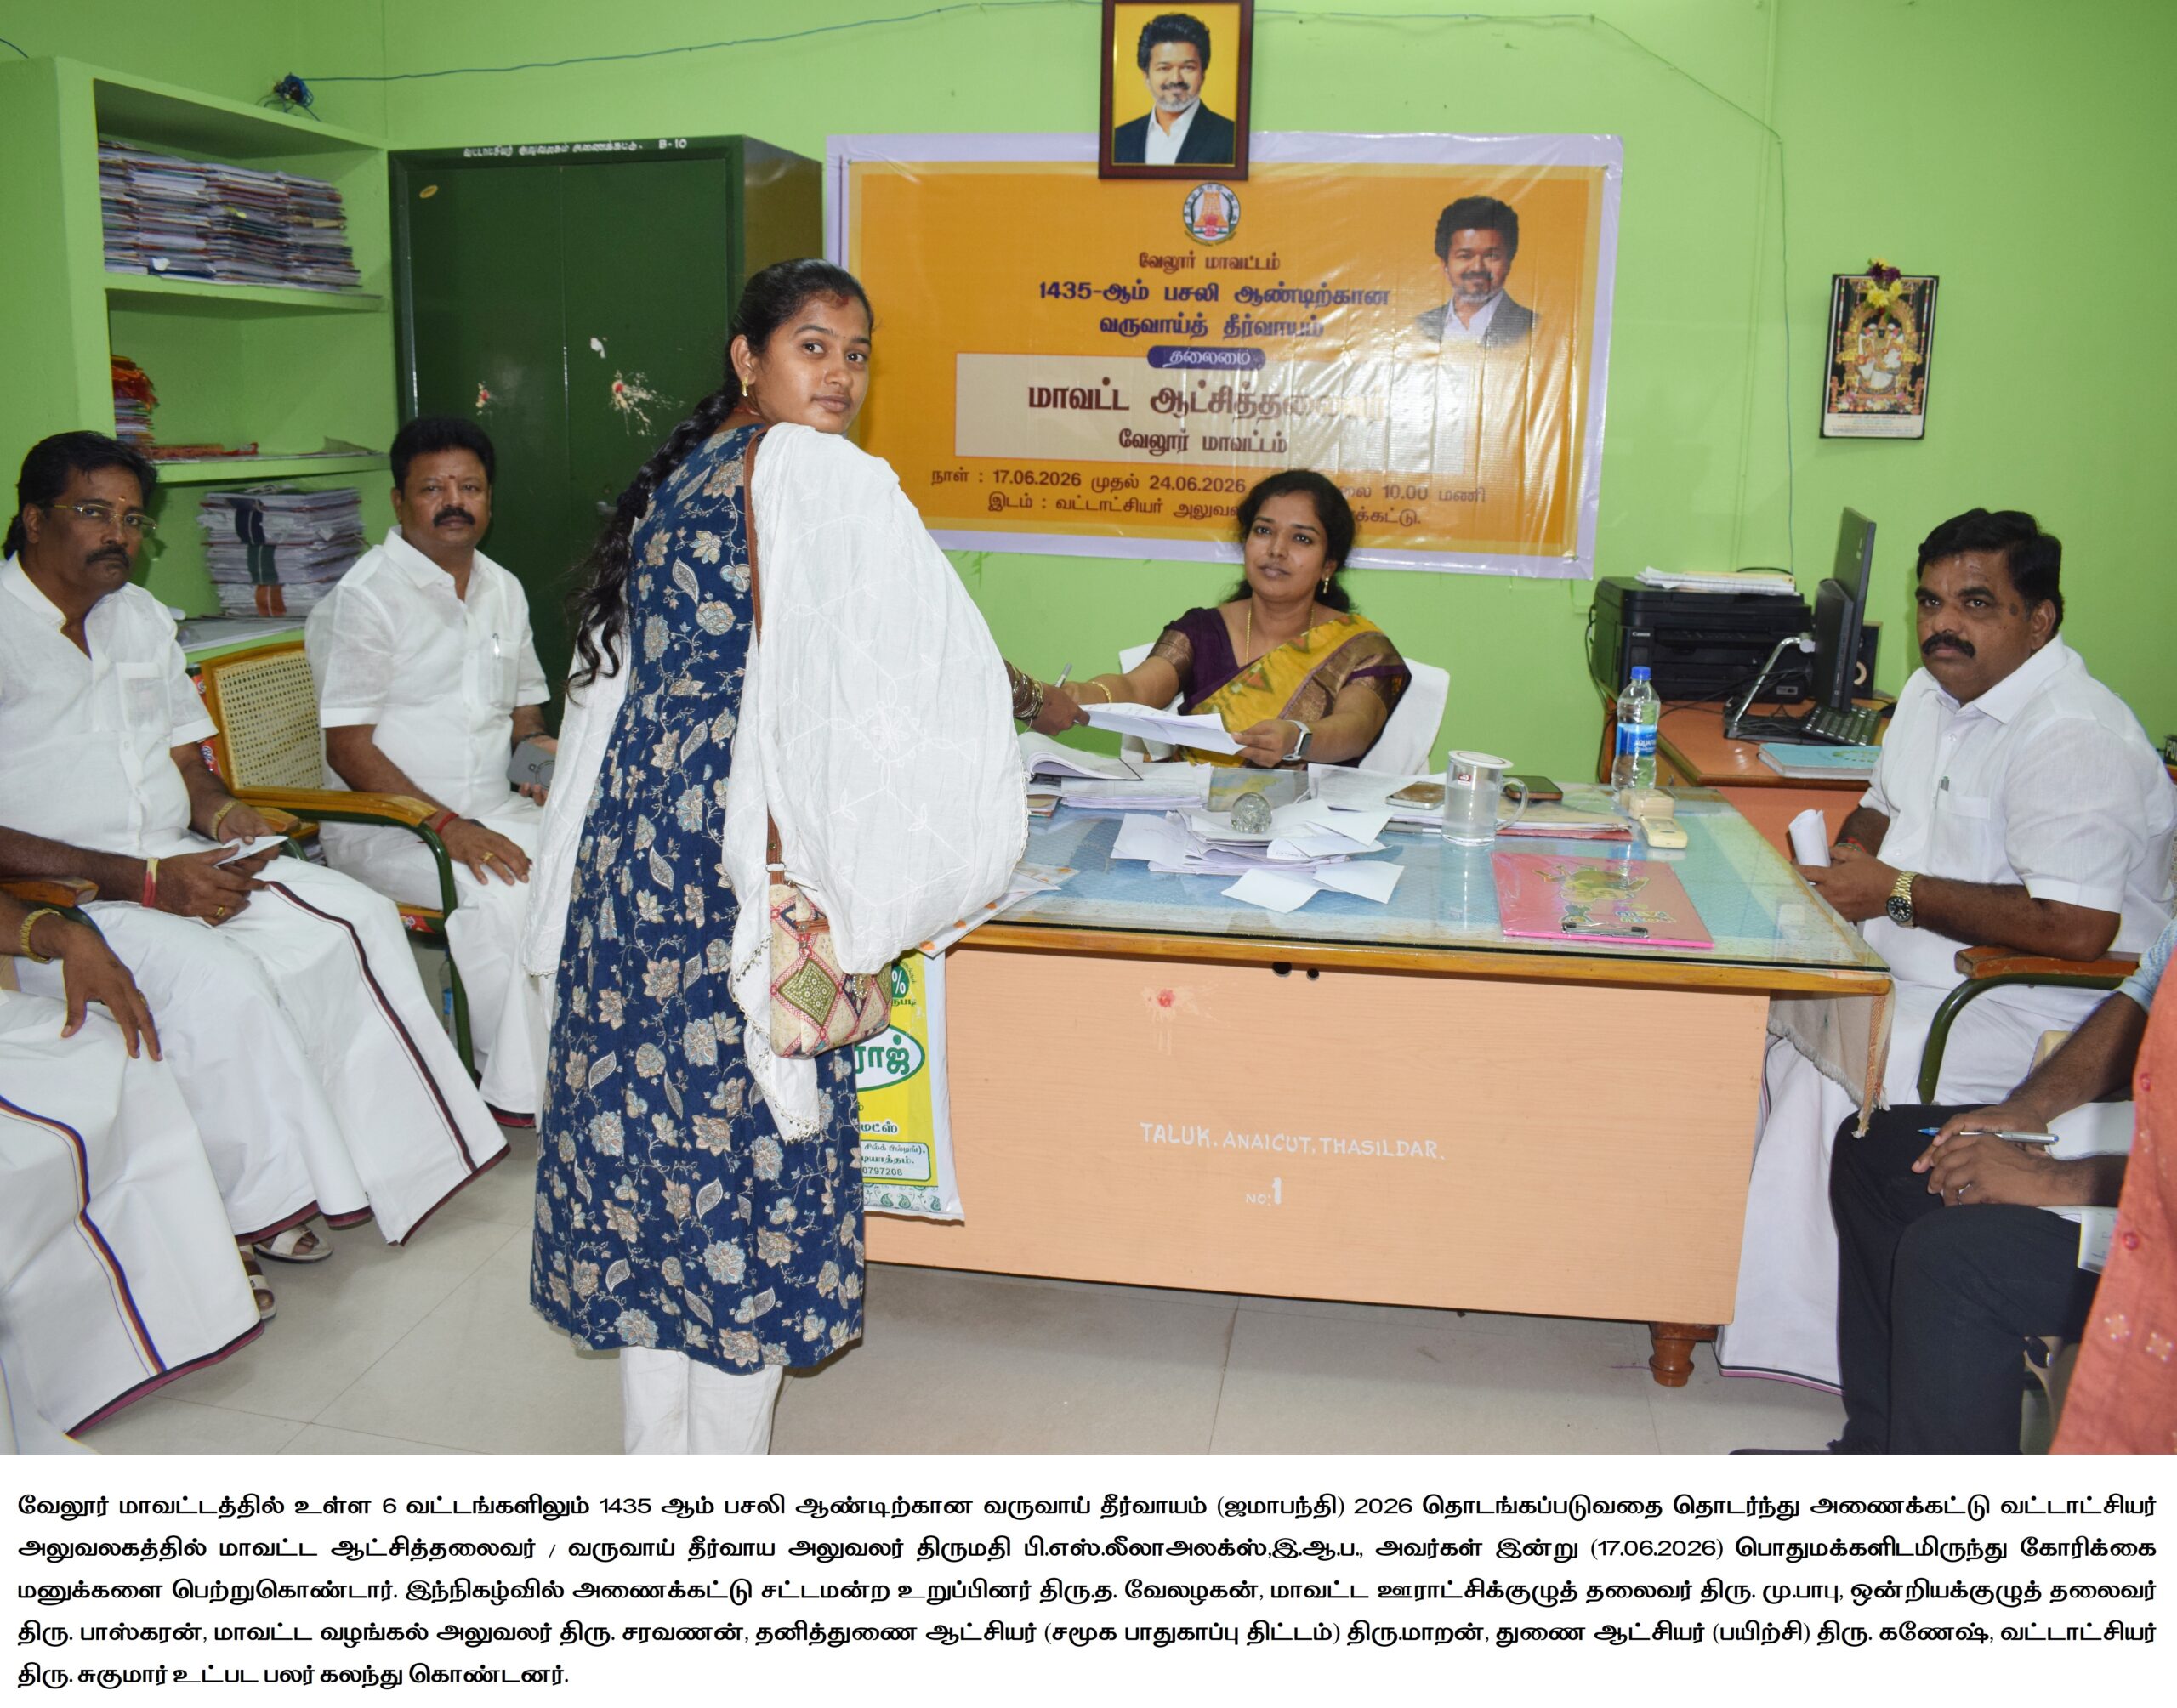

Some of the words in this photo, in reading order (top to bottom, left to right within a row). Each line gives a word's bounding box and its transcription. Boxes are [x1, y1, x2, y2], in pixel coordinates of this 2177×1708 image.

[1139, 251, 1196, 274] வேலூர்
[1205, 252, 1281, 270] மாவட்டம்
[1040, 279, 1149, 304] 1435-ஆம்
[1164, 282, 1219, 303] பசலி
[1234, 281, 1390, 308] ஆண்டிற்கான
[1100, 312, 1208, 337] வருவாய்த்
[1223, 314, 1324, 338] தீர்வாயம்
[1162, 347, 1251, 368] தலைமை
[1028, 377, 1129, 411] மாவட்ட
[1118, 428, 1189, 456] வேலூர்
[1202, 430, 1287, 453] மாவட்டம்
[931, 467, 969, 485] நாள்
[992, 470, 1082, 486] 17.06.2026
[1091, 474, 1140, 493] முதல்
[1148, 475, 1246, 493] 24.06.2026
[1383, 484, 1429, 501] 10.00
[1438, 485, 1486, 503] மணி
[988, 492, 1033, 512] இடம்
[1055, 495, 1163, 514] வட்டாட்சியர்
[1356, 506, 1421, 527] க்கட்டு.
[861, 1166, 903, 1176] 0797208
